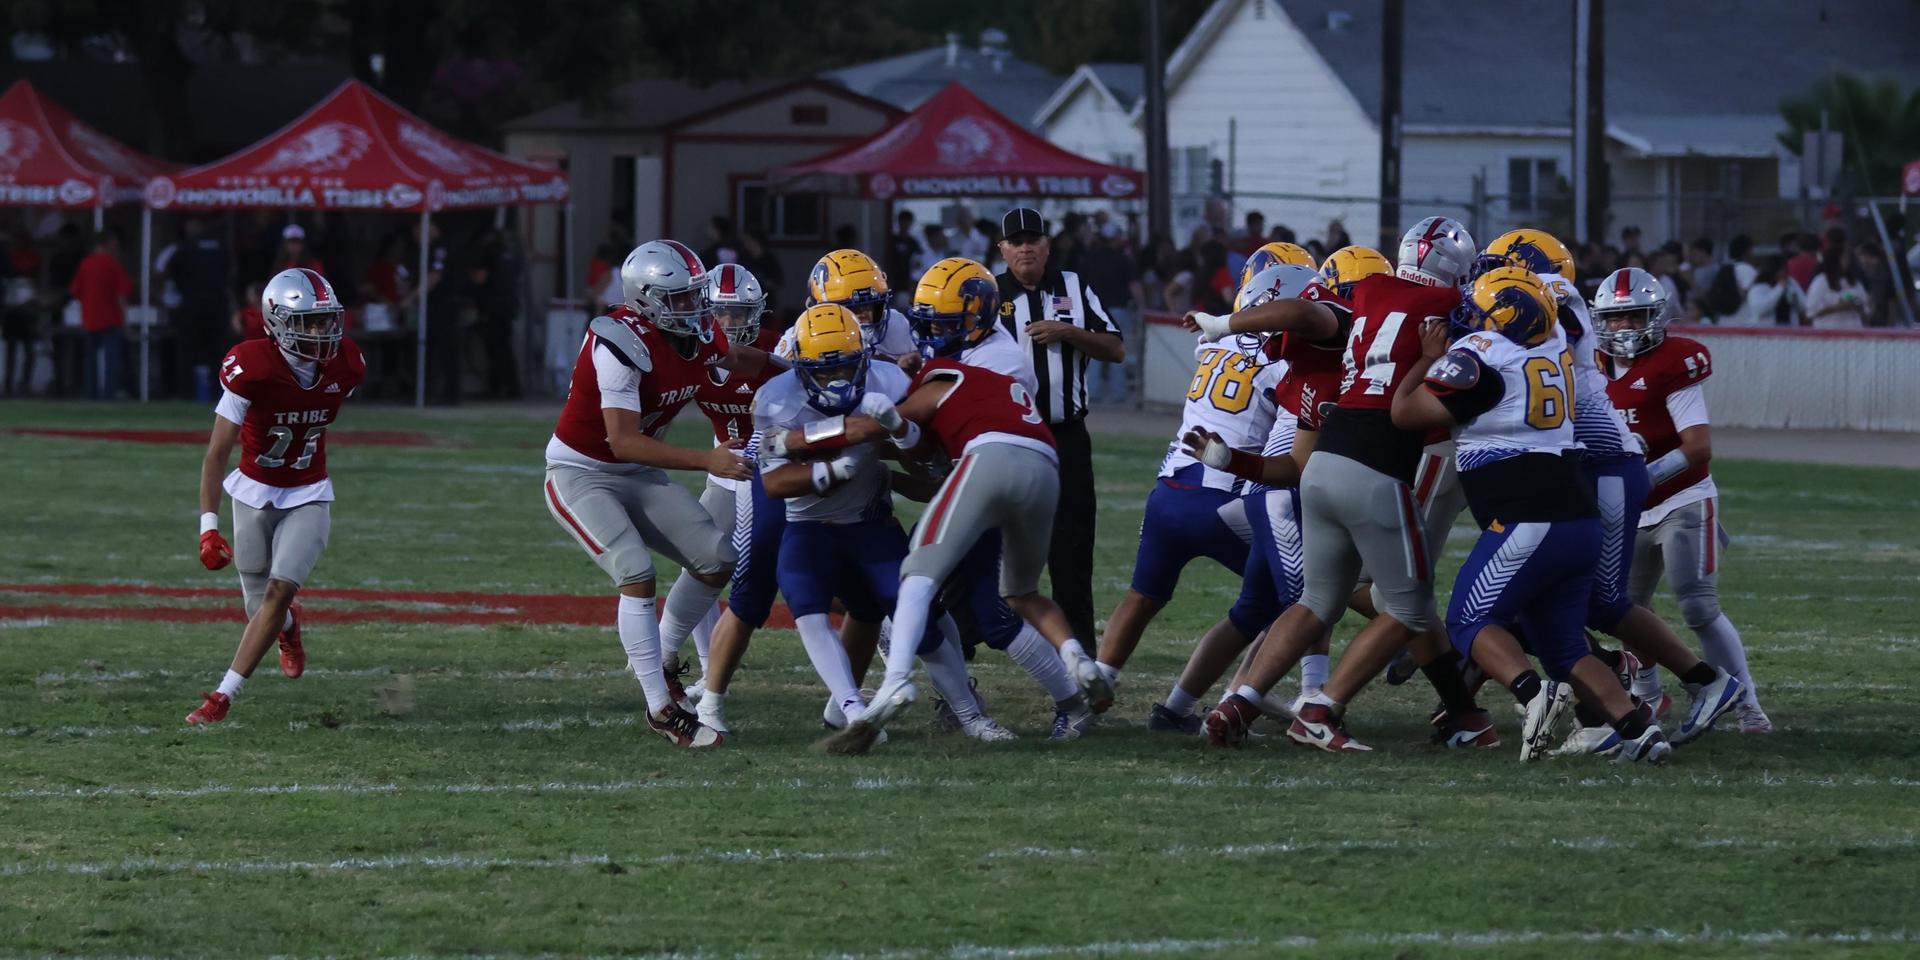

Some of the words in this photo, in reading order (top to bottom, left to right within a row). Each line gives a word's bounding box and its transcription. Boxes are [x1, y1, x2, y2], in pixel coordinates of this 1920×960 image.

[1400, 269, 1436, 287] Riddell
[1547, 280, 1570, 300] 5
[1186, 348, 1265, 415] 88
[273, 408, 330, 425] TRIBE
